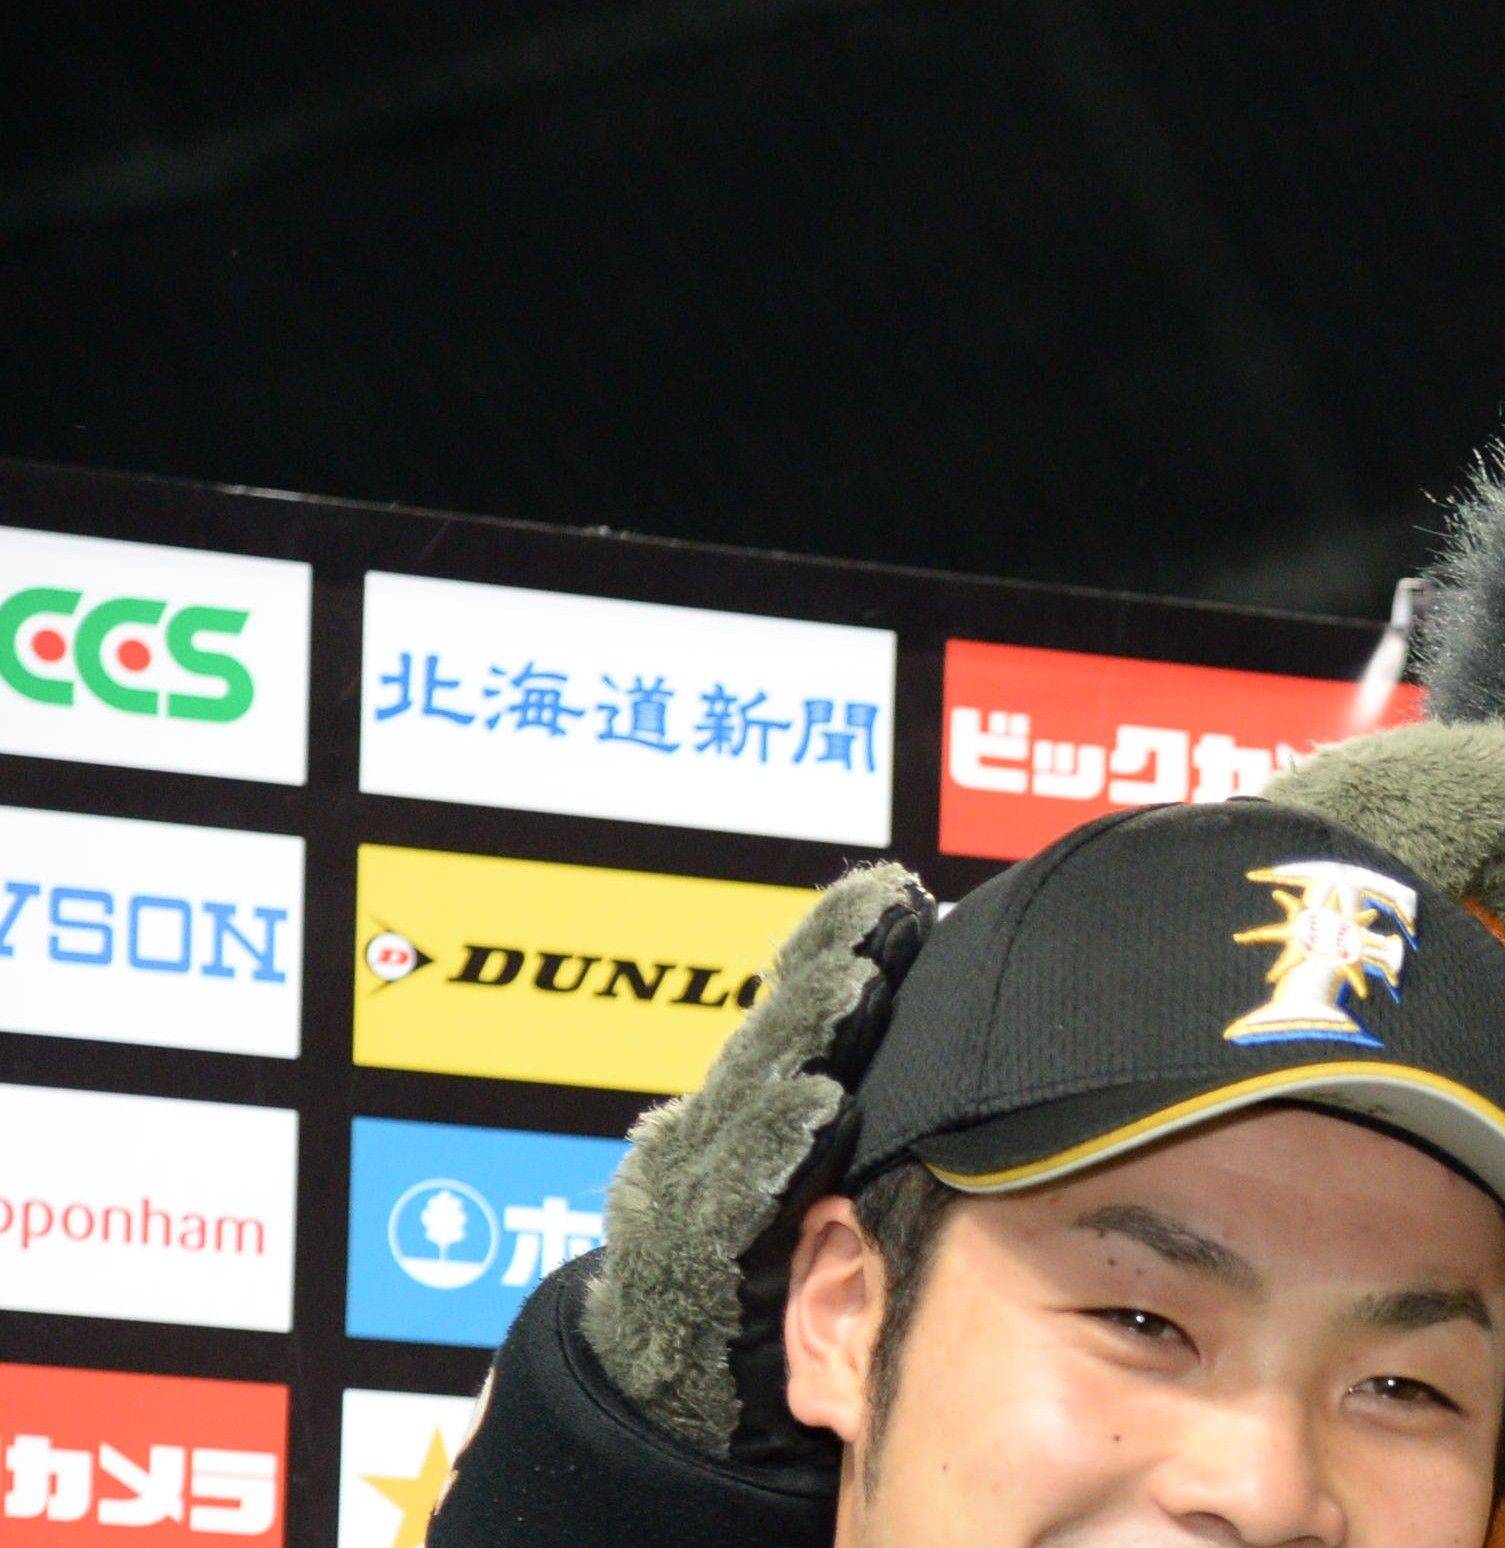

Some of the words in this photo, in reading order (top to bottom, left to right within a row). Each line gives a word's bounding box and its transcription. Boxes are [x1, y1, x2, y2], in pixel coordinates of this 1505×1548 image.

[375, 652, 880, 775] 北海道新聞
[951, 706, 1304, 804] ビックカ
[4, 1433, 277, 1537] カメラ
